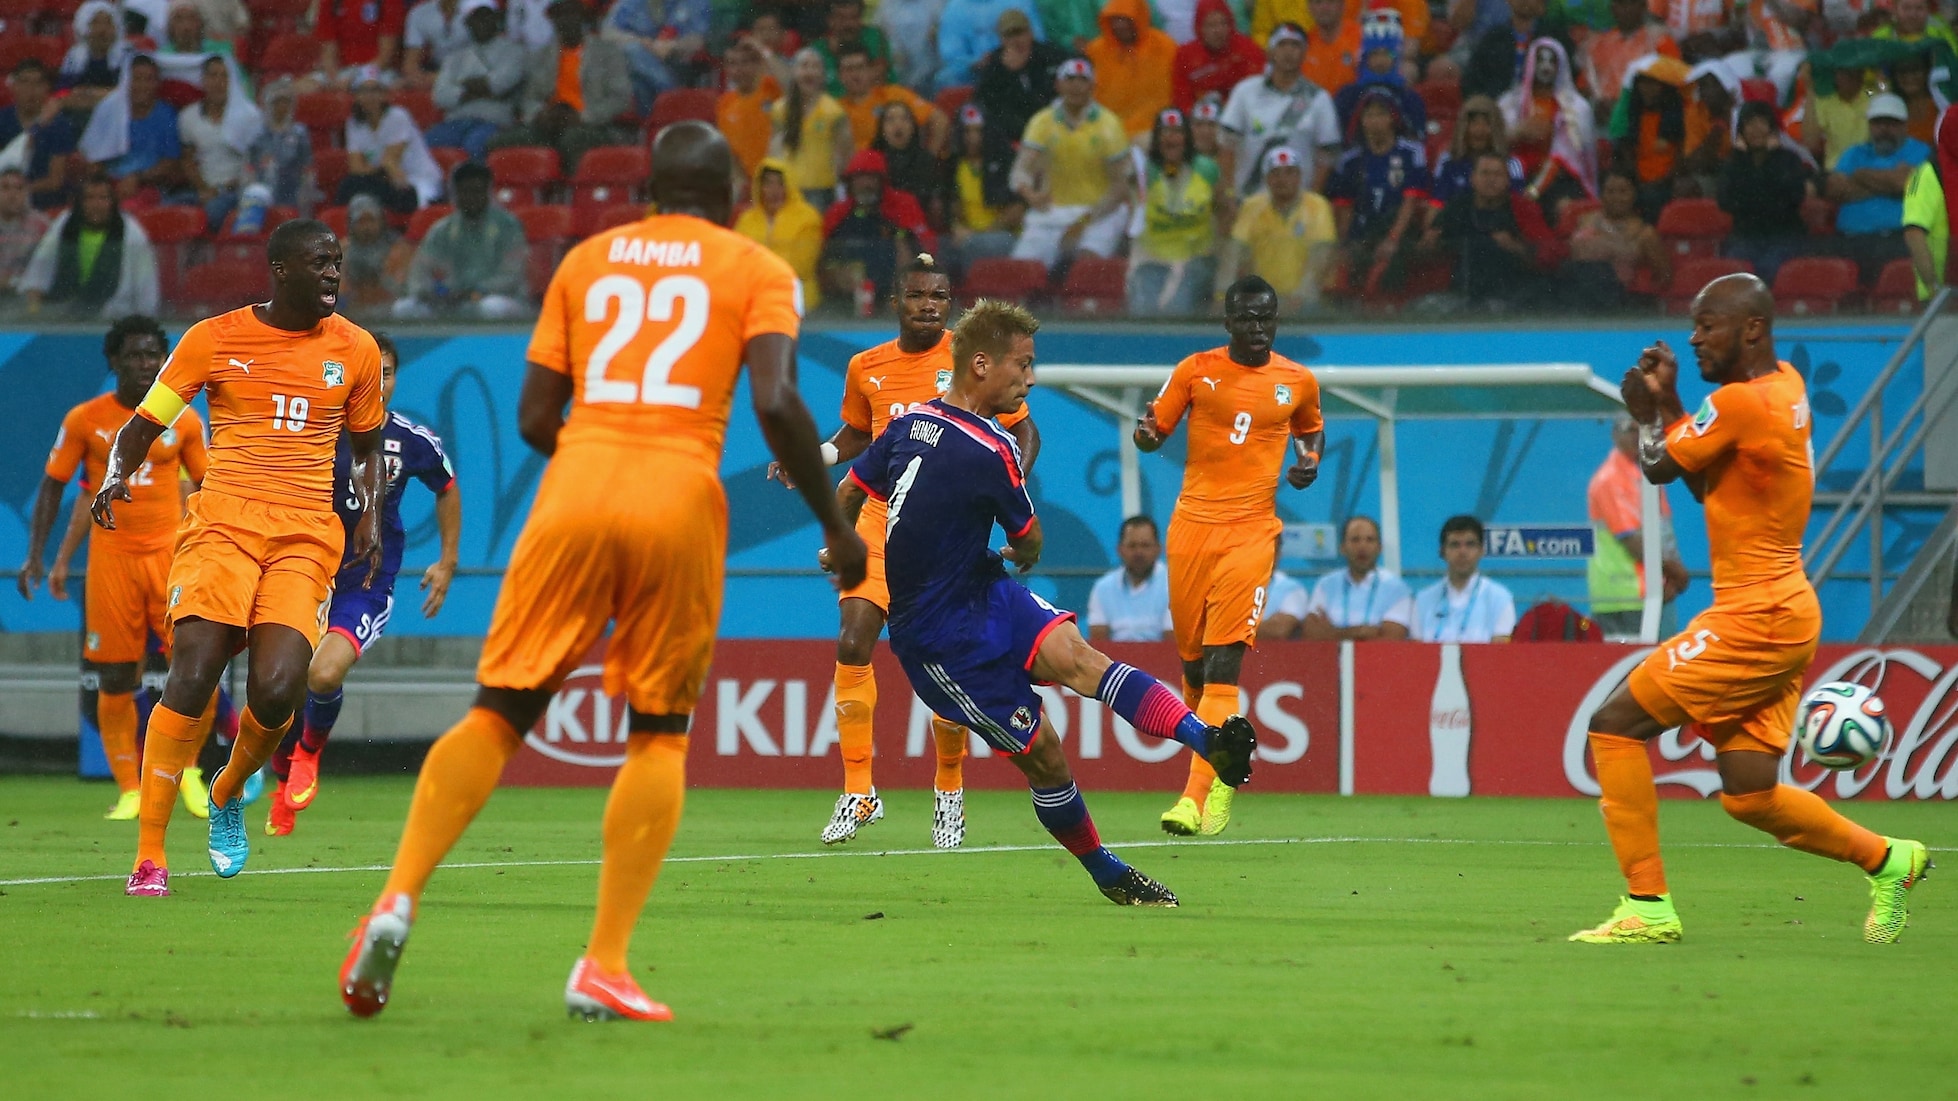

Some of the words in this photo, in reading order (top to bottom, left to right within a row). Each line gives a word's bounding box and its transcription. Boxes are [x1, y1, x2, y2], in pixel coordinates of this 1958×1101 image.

[608, 237, 701, 266] BAMBA
[584, 274, 710, 409] 22
[272, 394, 309, 432] 19
[1229, 412, 1252, 445] 9
[910, 420, 944, 447] HONDA
[1252, 586, 1265, 619] 9
[1679, 629, 1720, 660] 5
[906, 680, 1309, 764] MTOS
